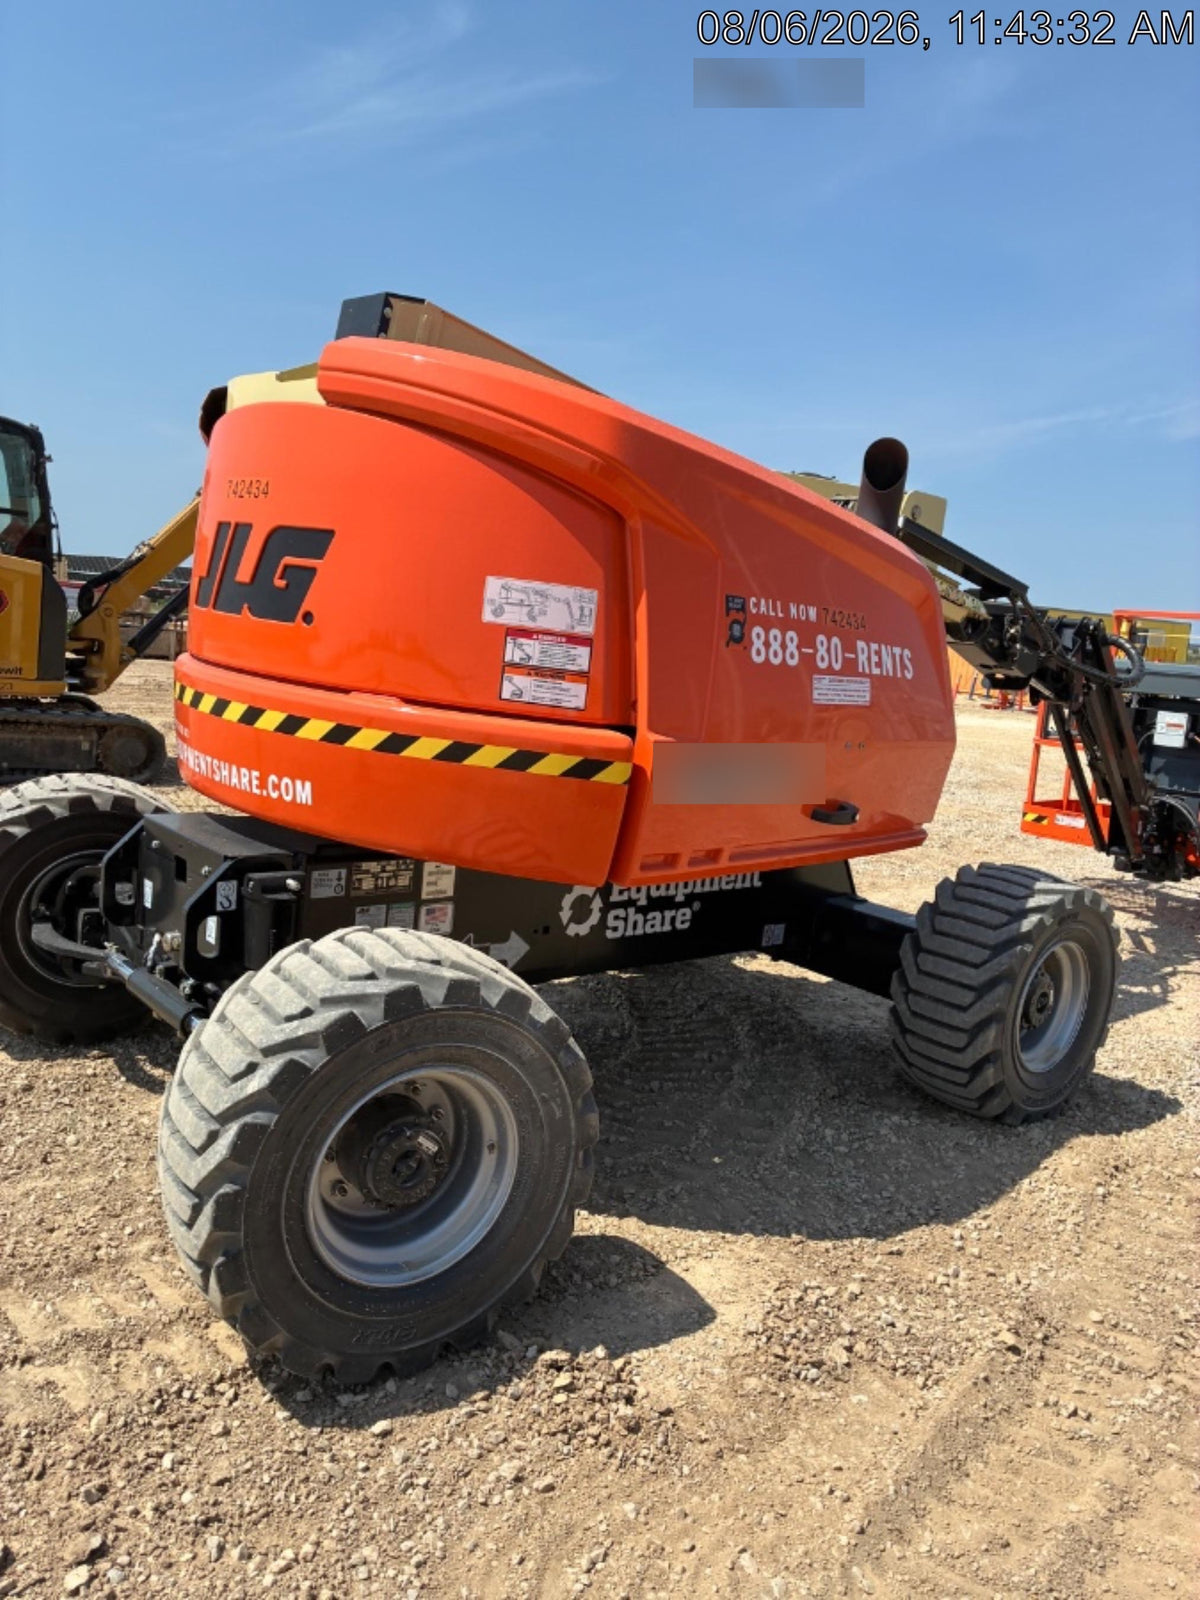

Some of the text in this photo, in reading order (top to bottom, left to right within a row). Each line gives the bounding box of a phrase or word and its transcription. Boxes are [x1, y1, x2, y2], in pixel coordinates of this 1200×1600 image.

[226, 479, 270, 499] 742434
[749, 596, 785, 618] CALL
[789, 602, 818, 623] NOW
[822, 607, 867, 631] 742434
[750, 625, 915, 681] 888-80-RENTS
